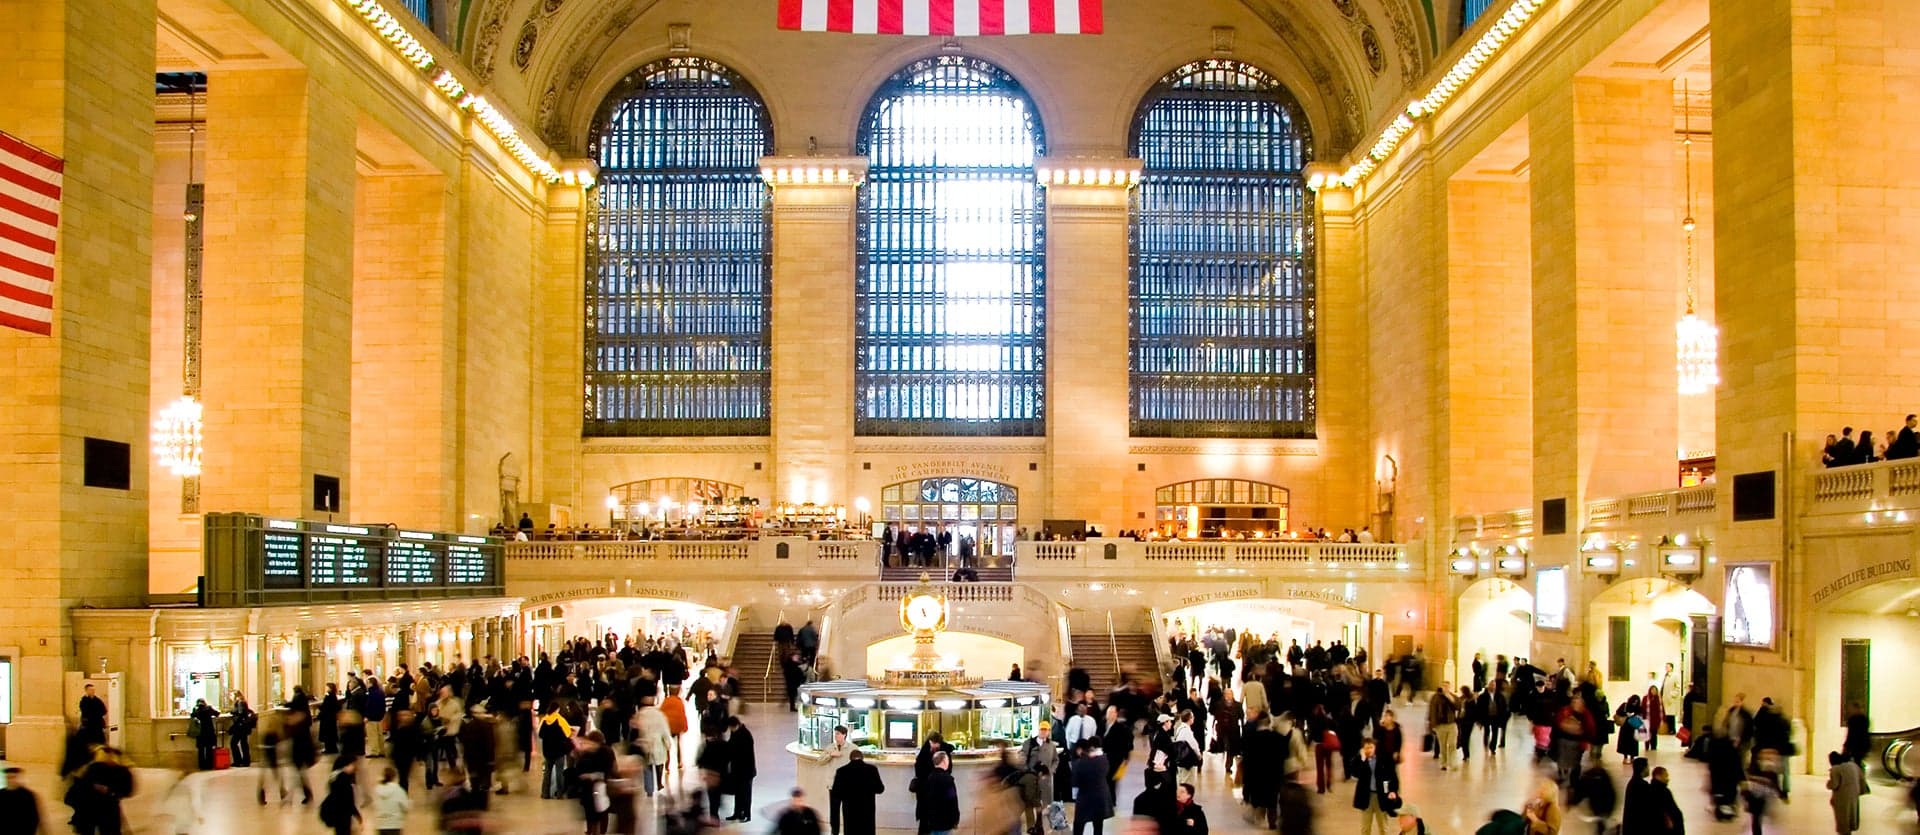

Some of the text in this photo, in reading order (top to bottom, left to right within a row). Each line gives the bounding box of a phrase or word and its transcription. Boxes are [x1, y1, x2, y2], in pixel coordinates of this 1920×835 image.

[911, 460, 965, 469] VANDERBILT
[911, 467, 955, 476] CAMPBELL
[961, 468, 1010, 481] APARTMENT
[1812, 559, 1911, 603] THE METLIFE BUILDING
[531, 587, 606, 602] SUBWAY SHUTTLE
[1182, 588, 1258, 605] TICKET MACHINES
[1287, 589, 1320, 599] TRACKS
